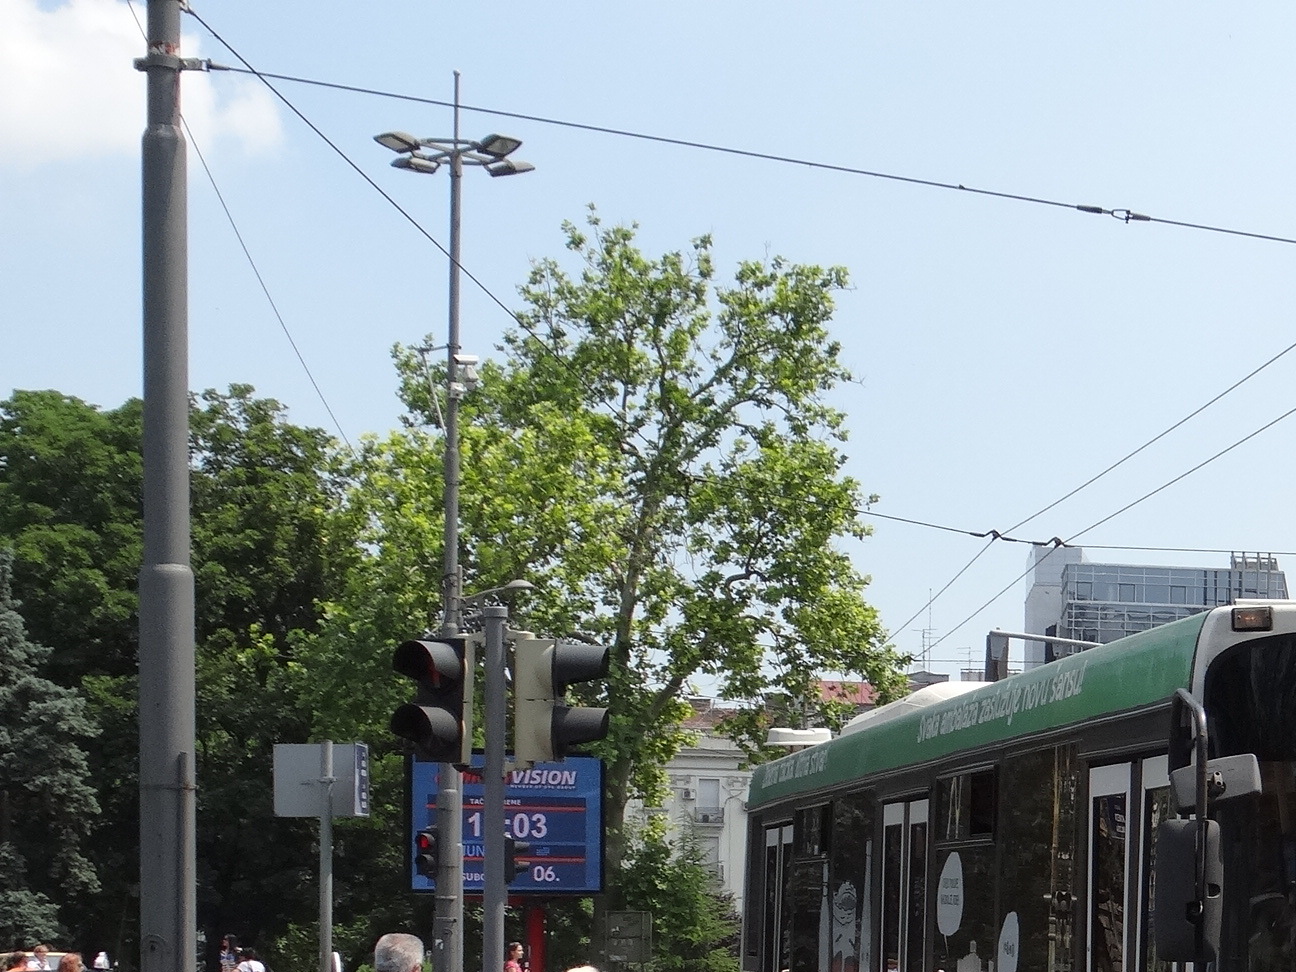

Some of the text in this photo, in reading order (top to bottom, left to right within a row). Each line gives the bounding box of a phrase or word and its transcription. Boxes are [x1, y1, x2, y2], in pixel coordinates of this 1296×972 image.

[1021, 679, 1049, 713] novu
[1049, 660, 1088, 704] šansu!
[511, 769, 577, 786] VISION
[468, 812, 548, 839] 1:03
[533, 865, 560, 882] 06.
